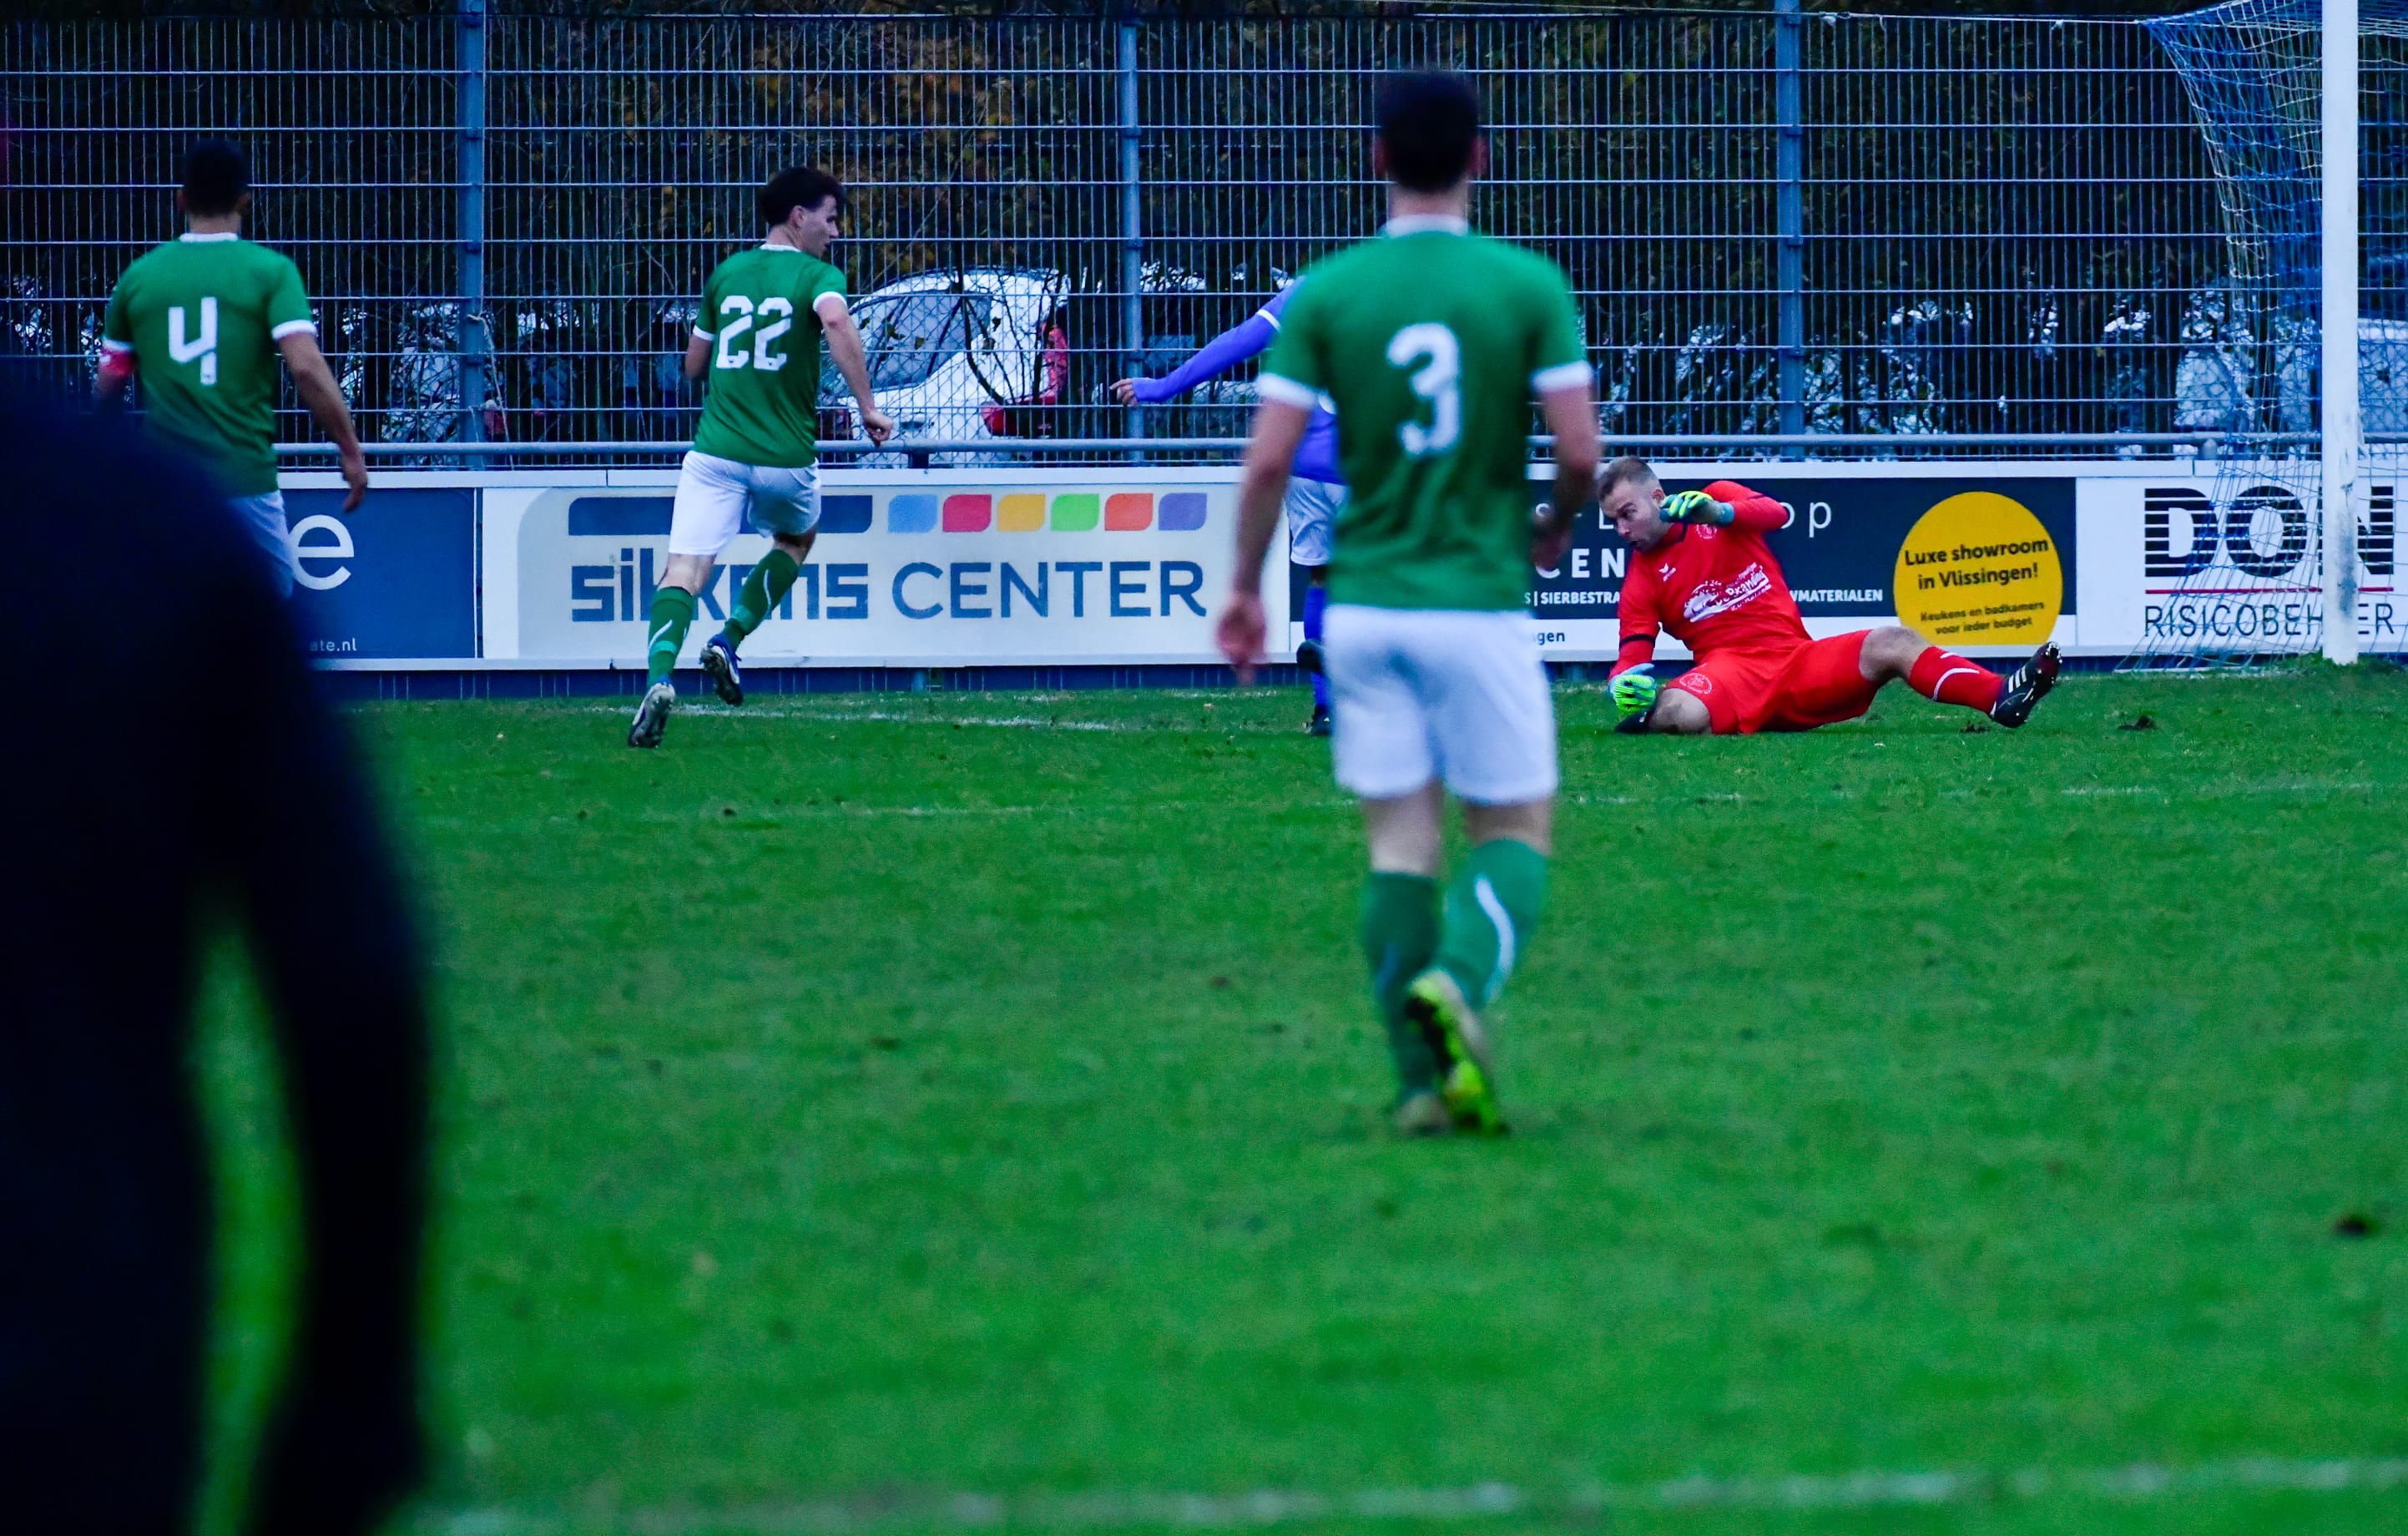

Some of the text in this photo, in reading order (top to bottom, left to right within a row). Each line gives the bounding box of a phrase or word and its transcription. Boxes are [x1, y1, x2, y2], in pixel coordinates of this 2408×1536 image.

[169, 296, 217, 387] 4
[715, 295, 794, 372] 22
[1386, 321, 1461, 456] 3
[1905, 539, 2049, 566] Luxe showroom
[891, 560, 1207, 620] CENTER
[1918, 563, 2039, 590] in Vlissingen!
[1921, 601, 2044, 622] Keukens en badkamers
[1936, 617, 2032, 635] voor ieder budget
[2144, 603, 2395, 637] RISICOBEHER
